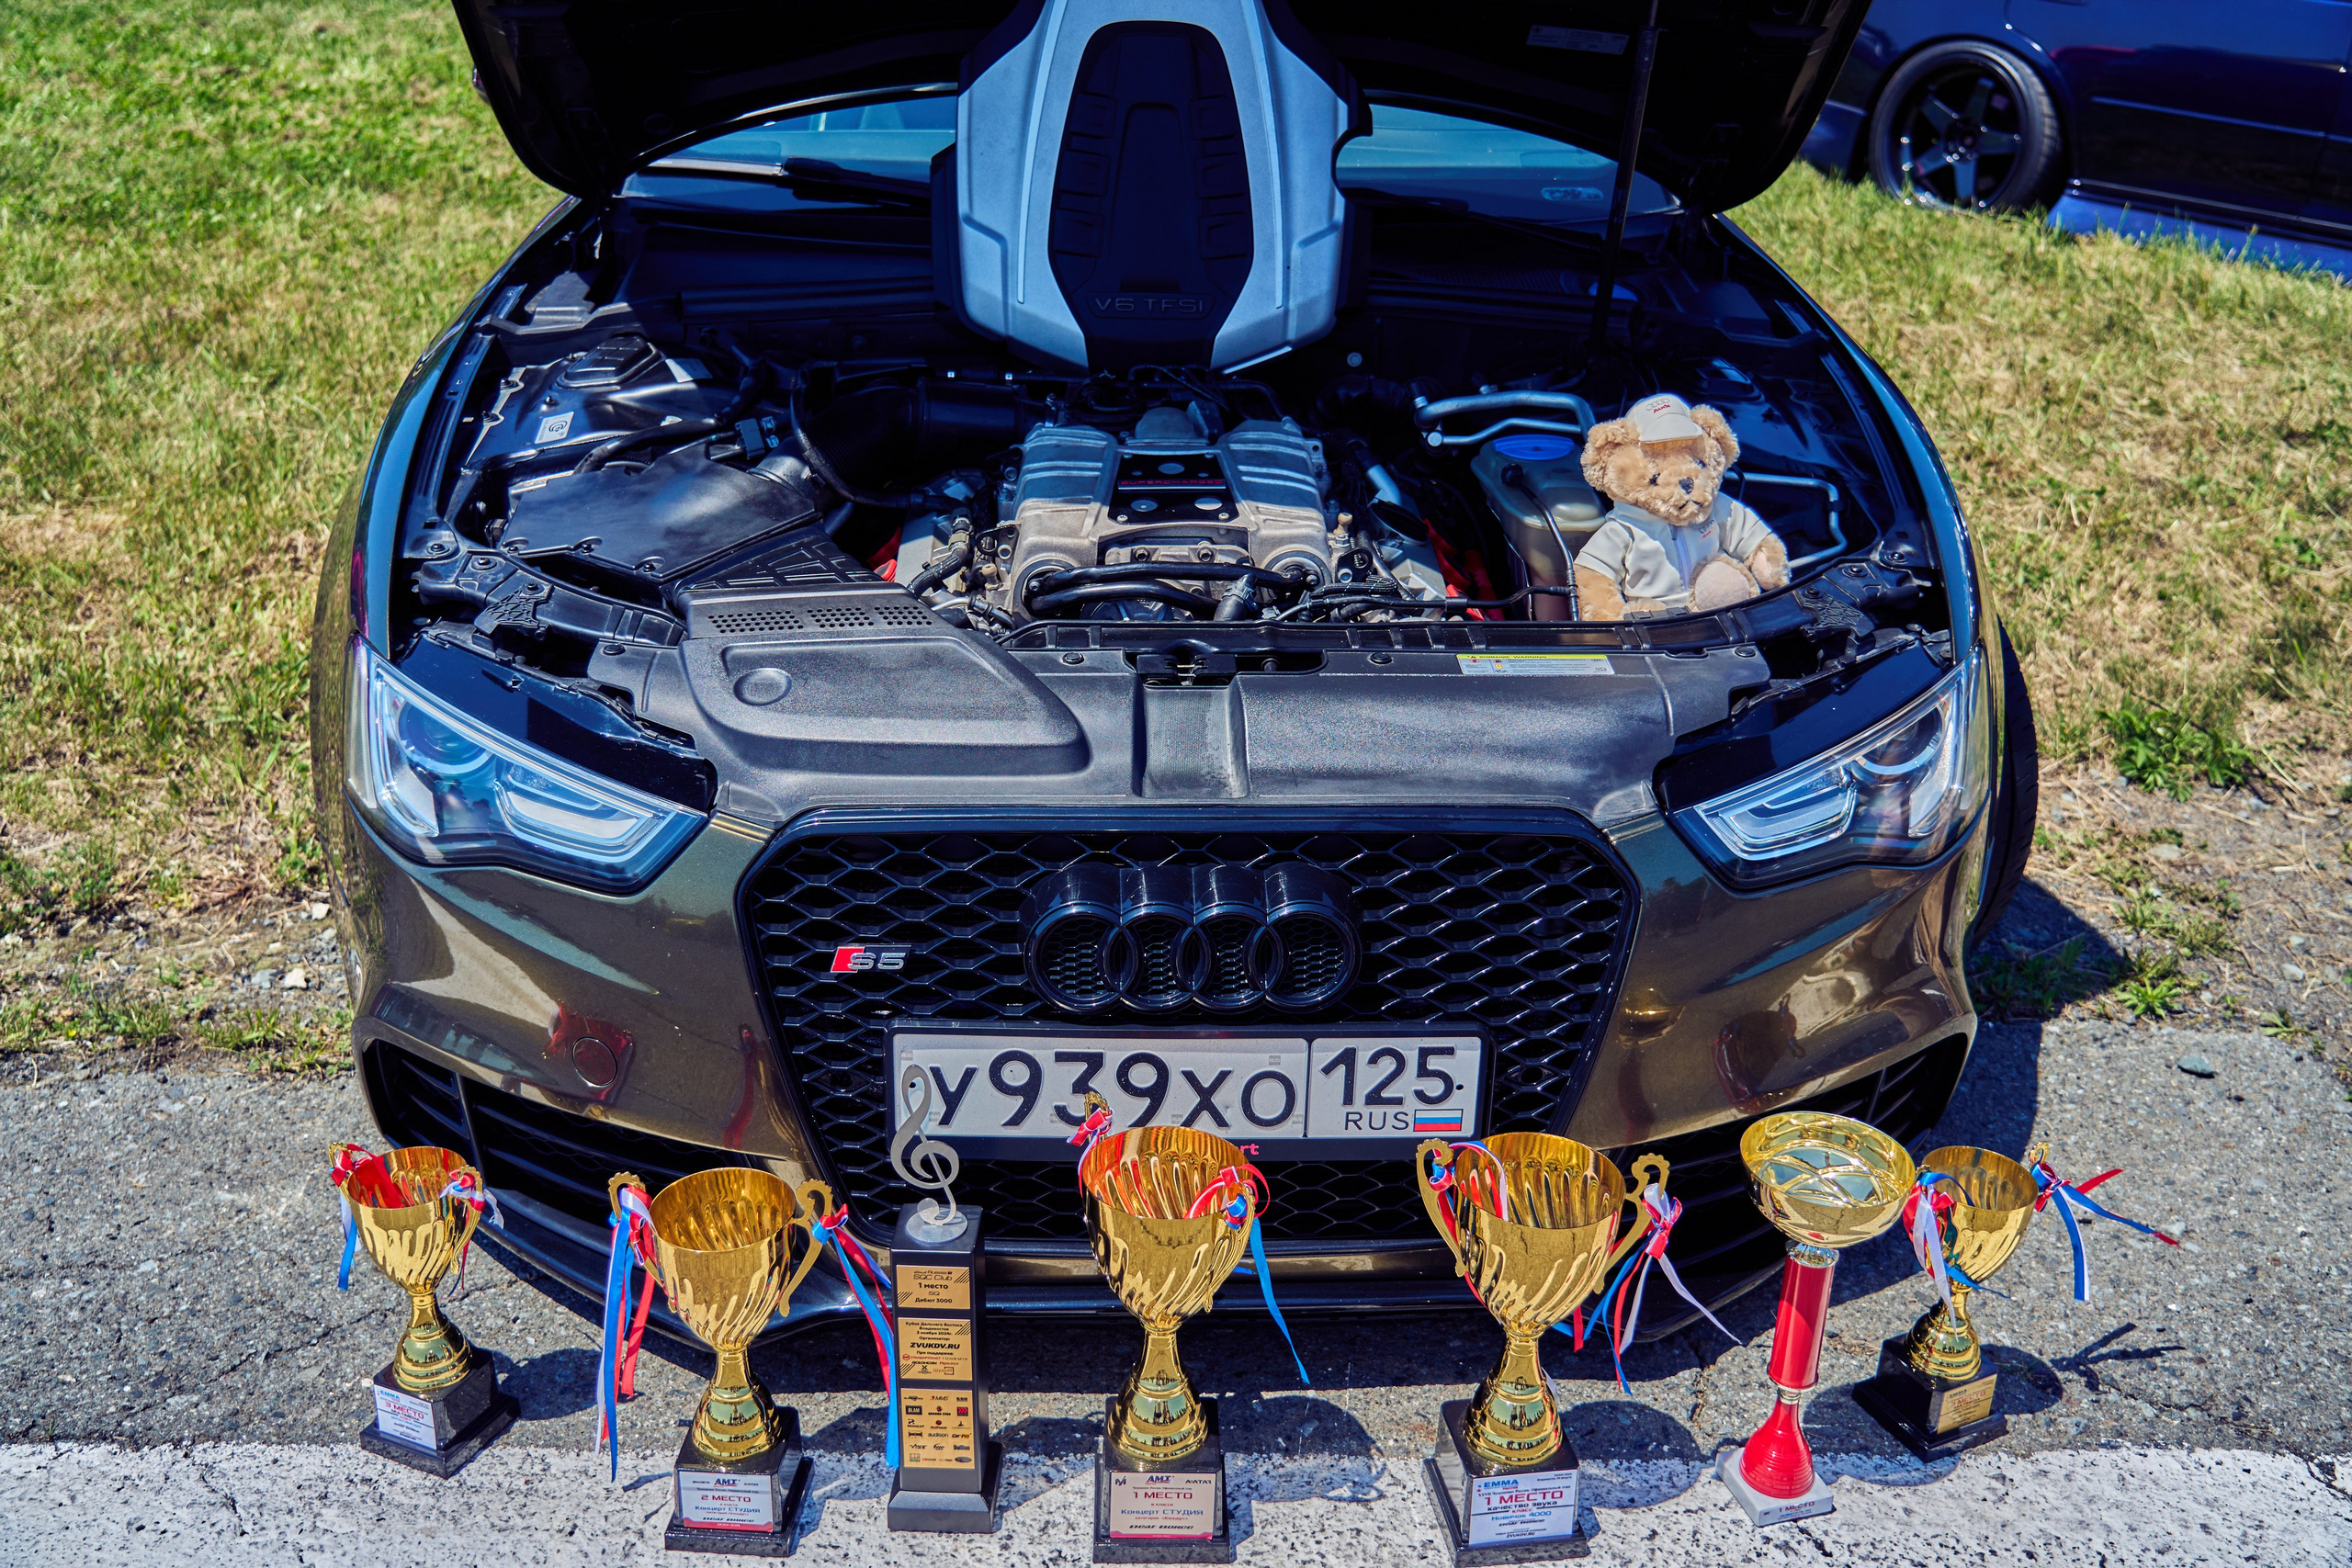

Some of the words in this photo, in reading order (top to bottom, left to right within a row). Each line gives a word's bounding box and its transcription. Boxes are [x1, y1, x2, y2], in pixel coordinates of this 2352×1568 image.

[1095, 298, 1135, 311] V6
[1142, 299, 1203, 313] TFSI
[1653, 404, 1670, 413] Audi
[847, 952, 906, 970] S5
[1319, 1045, 1455, 1106] 125
[1345, 1111, 1409, 1130] RUS
[393, 1404, 424, 1419] МЕСТО
[1484, 1479, 1518, 1488] EMMA
[1484, 1497, 1490, 1505] 1
[1499, 1490, 1563, 1504] МЕСТО
[1785, 1501, 1815, 1511] МЕСТО
